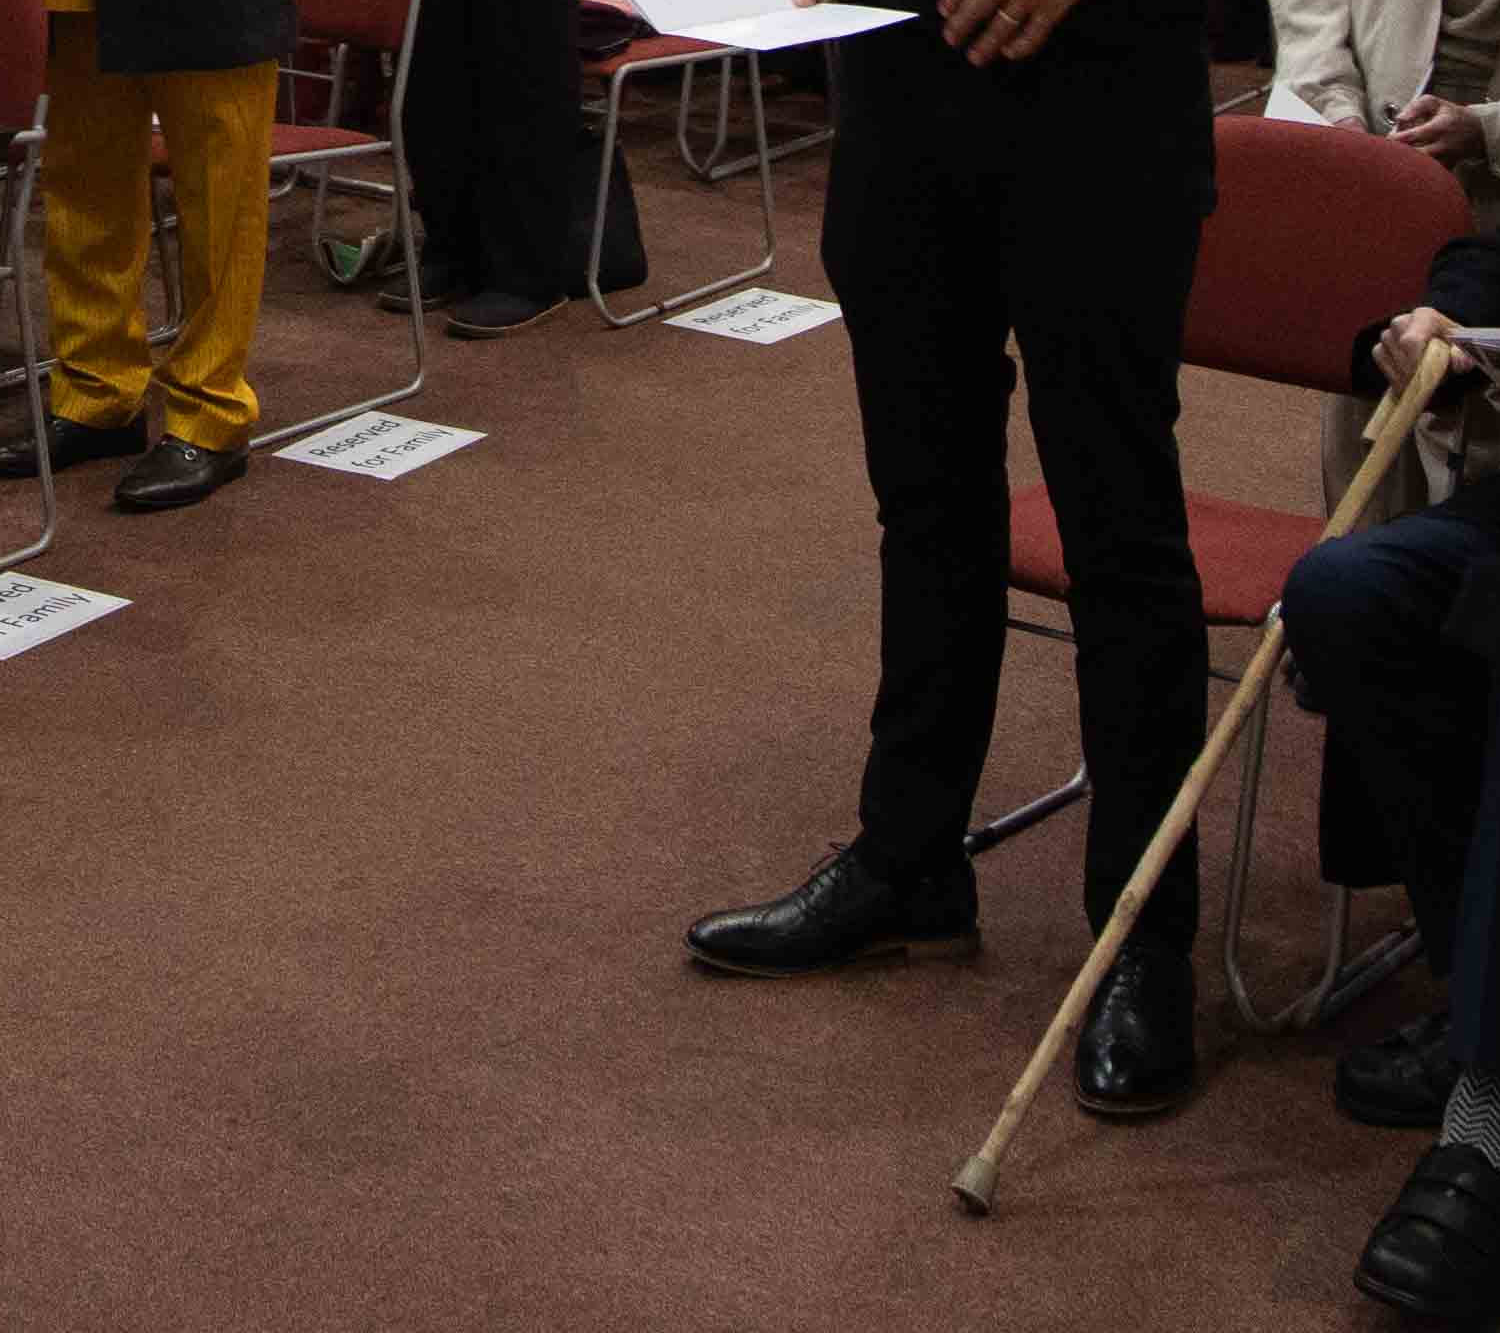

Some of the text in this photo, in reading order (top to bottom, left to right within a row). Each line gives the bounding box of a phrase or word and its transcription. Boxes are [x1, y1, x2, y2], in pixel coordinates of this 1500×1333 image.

[692, 293, 779, 326] Reserved
[730, 322, 761, 335] for
[309, 419, 402, 458] Reserved
[351, 428, 455, 469] for Family
[3, 592, 93, 629] Family
